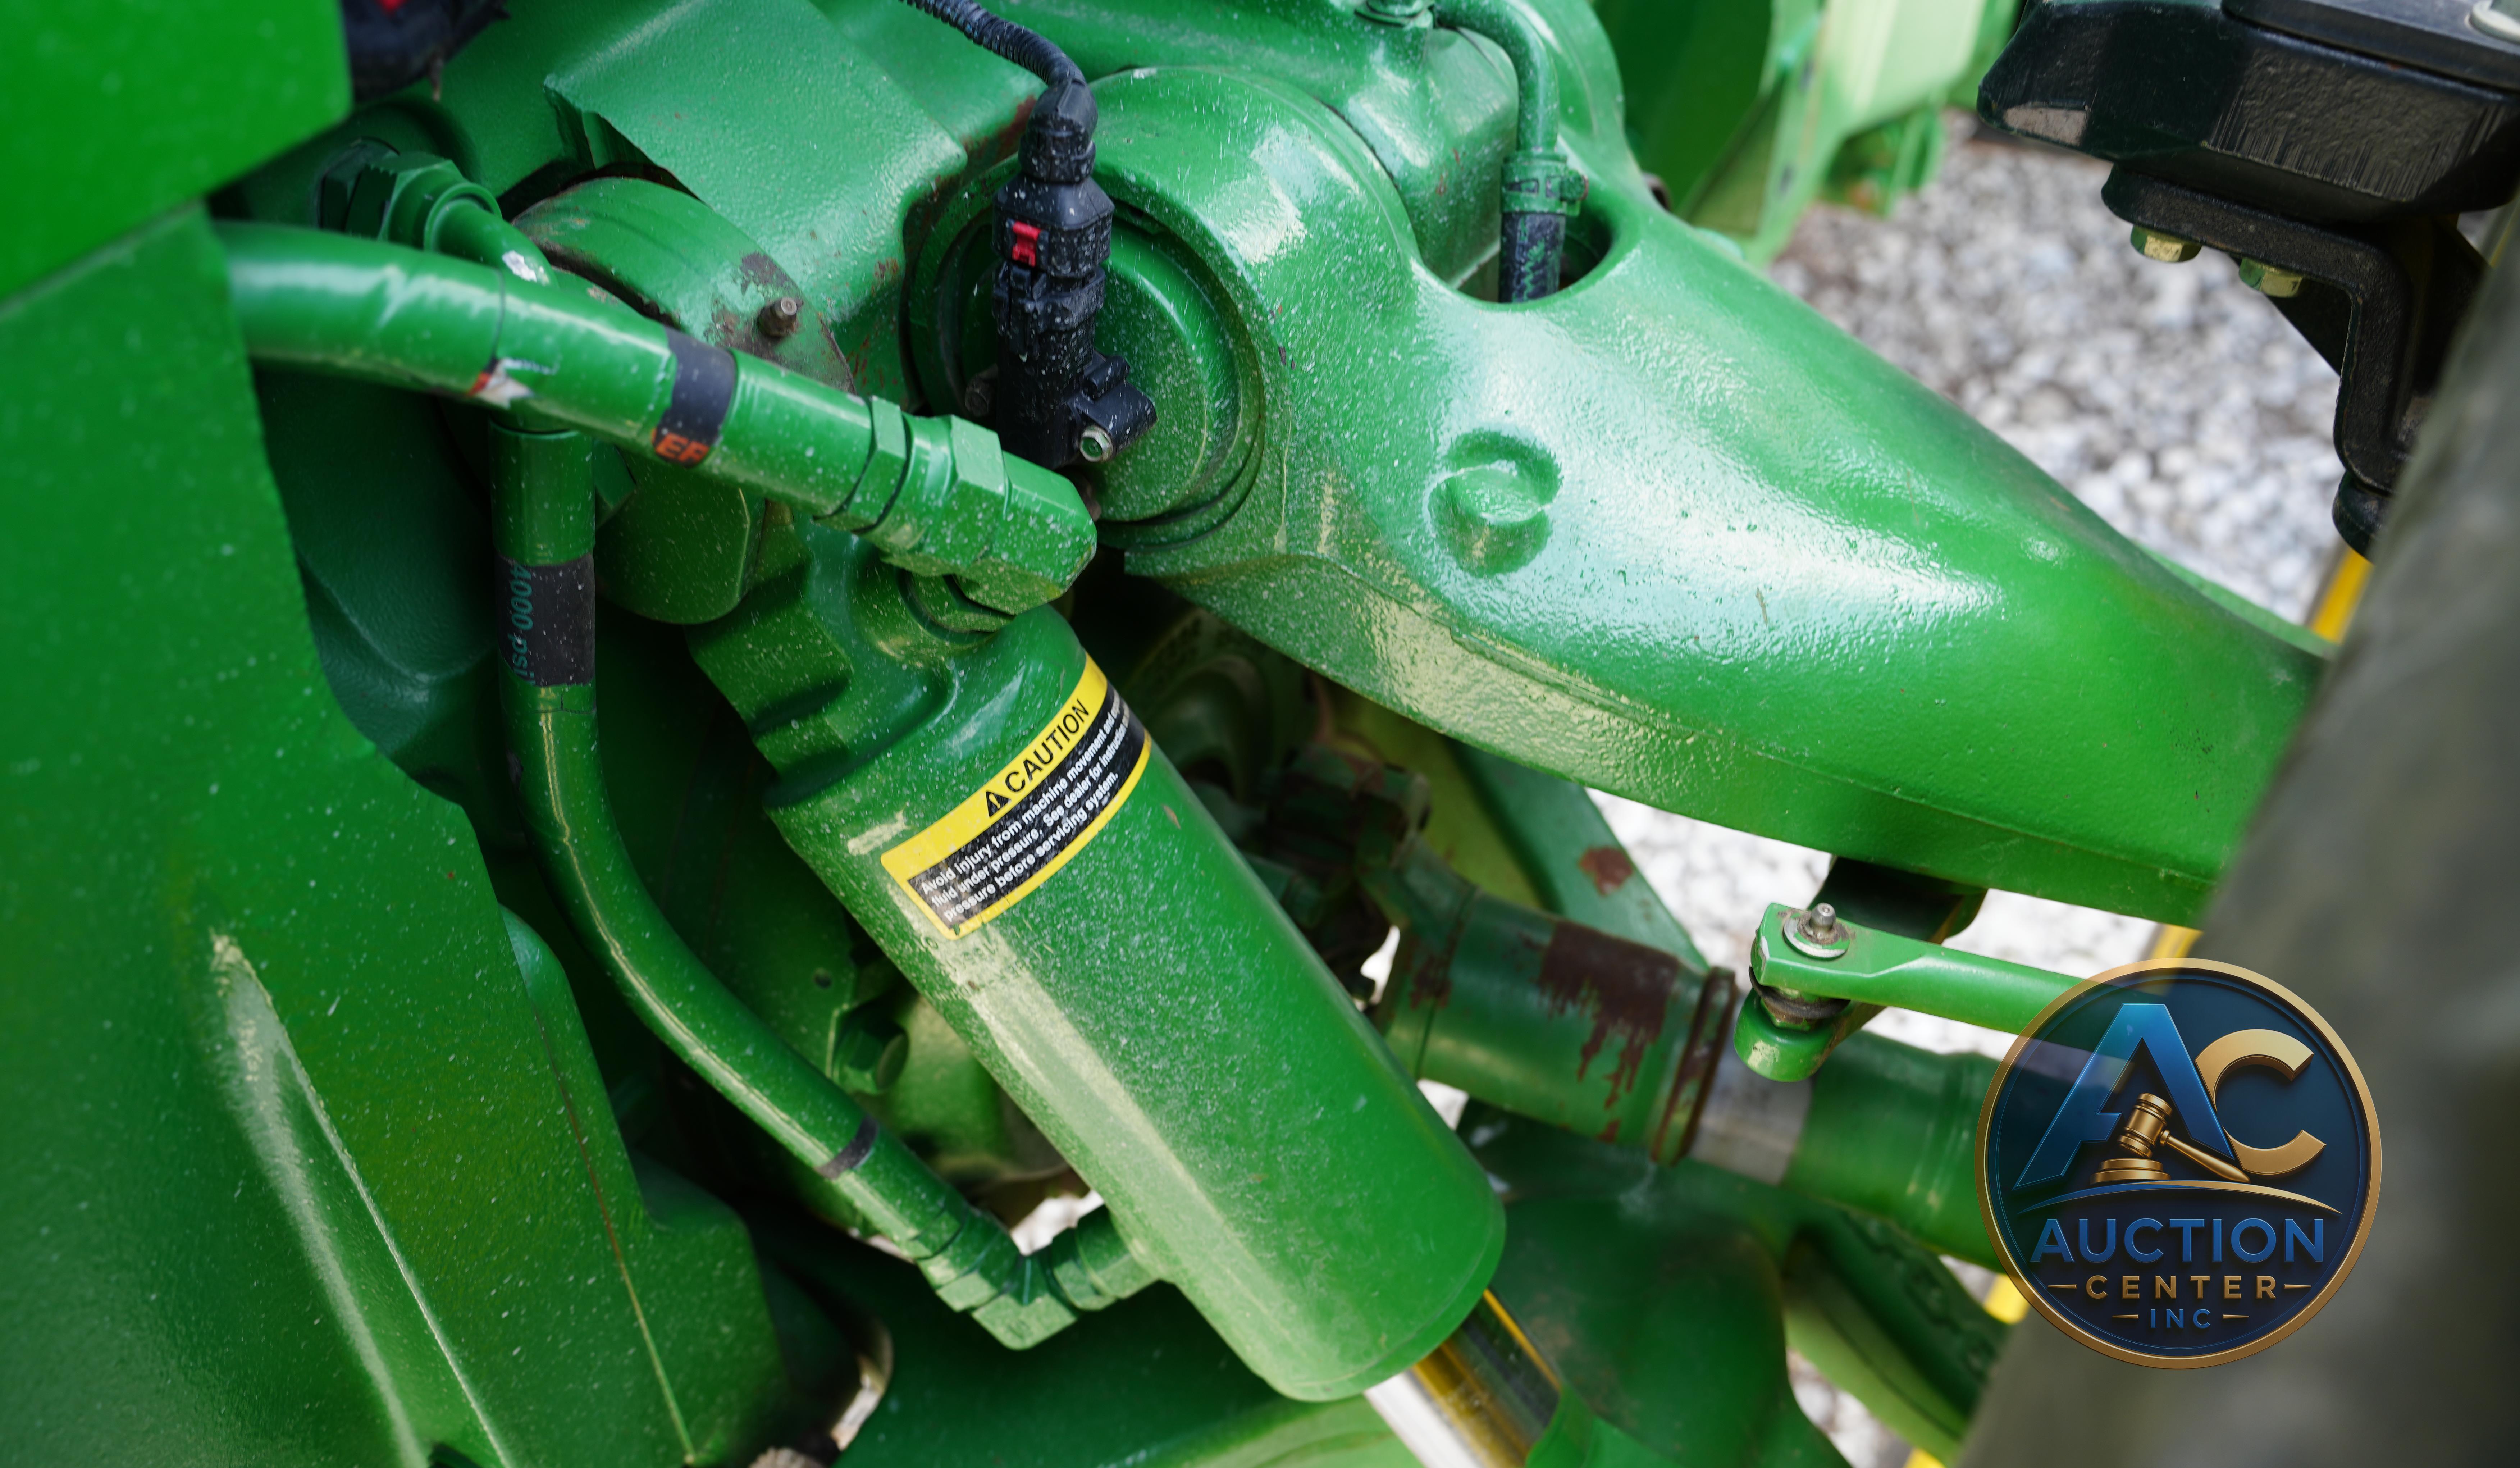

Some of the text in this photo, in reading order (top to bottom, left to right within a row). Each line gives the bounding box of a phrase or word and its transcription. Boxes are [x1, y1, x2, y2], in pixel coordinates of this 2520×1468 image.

[508, 564, 536, 683] 4000 psi
[922, 867, 956, 895] Avoid
[954, 843, 992, 874] injury
[991, 821, 1022, 848] from
[1022, 778, 1068, 825] machine
[1067, 728, 1107, 782] movement
[1103, 712, 1115, 734] and
[1005, 698, 1089, 792] CAUTION
[932, 886, 958, 907] fluid
[958, 866, 990, 893] under
[991, 828, 1043, 873] pressure.
[1043, 805, 1064, 827] See
[1064, 775, 1091, 808] dealer
[1089, 762, 1102, 781] for
[944, 772, 1118, 922] pressure before servicing system.
